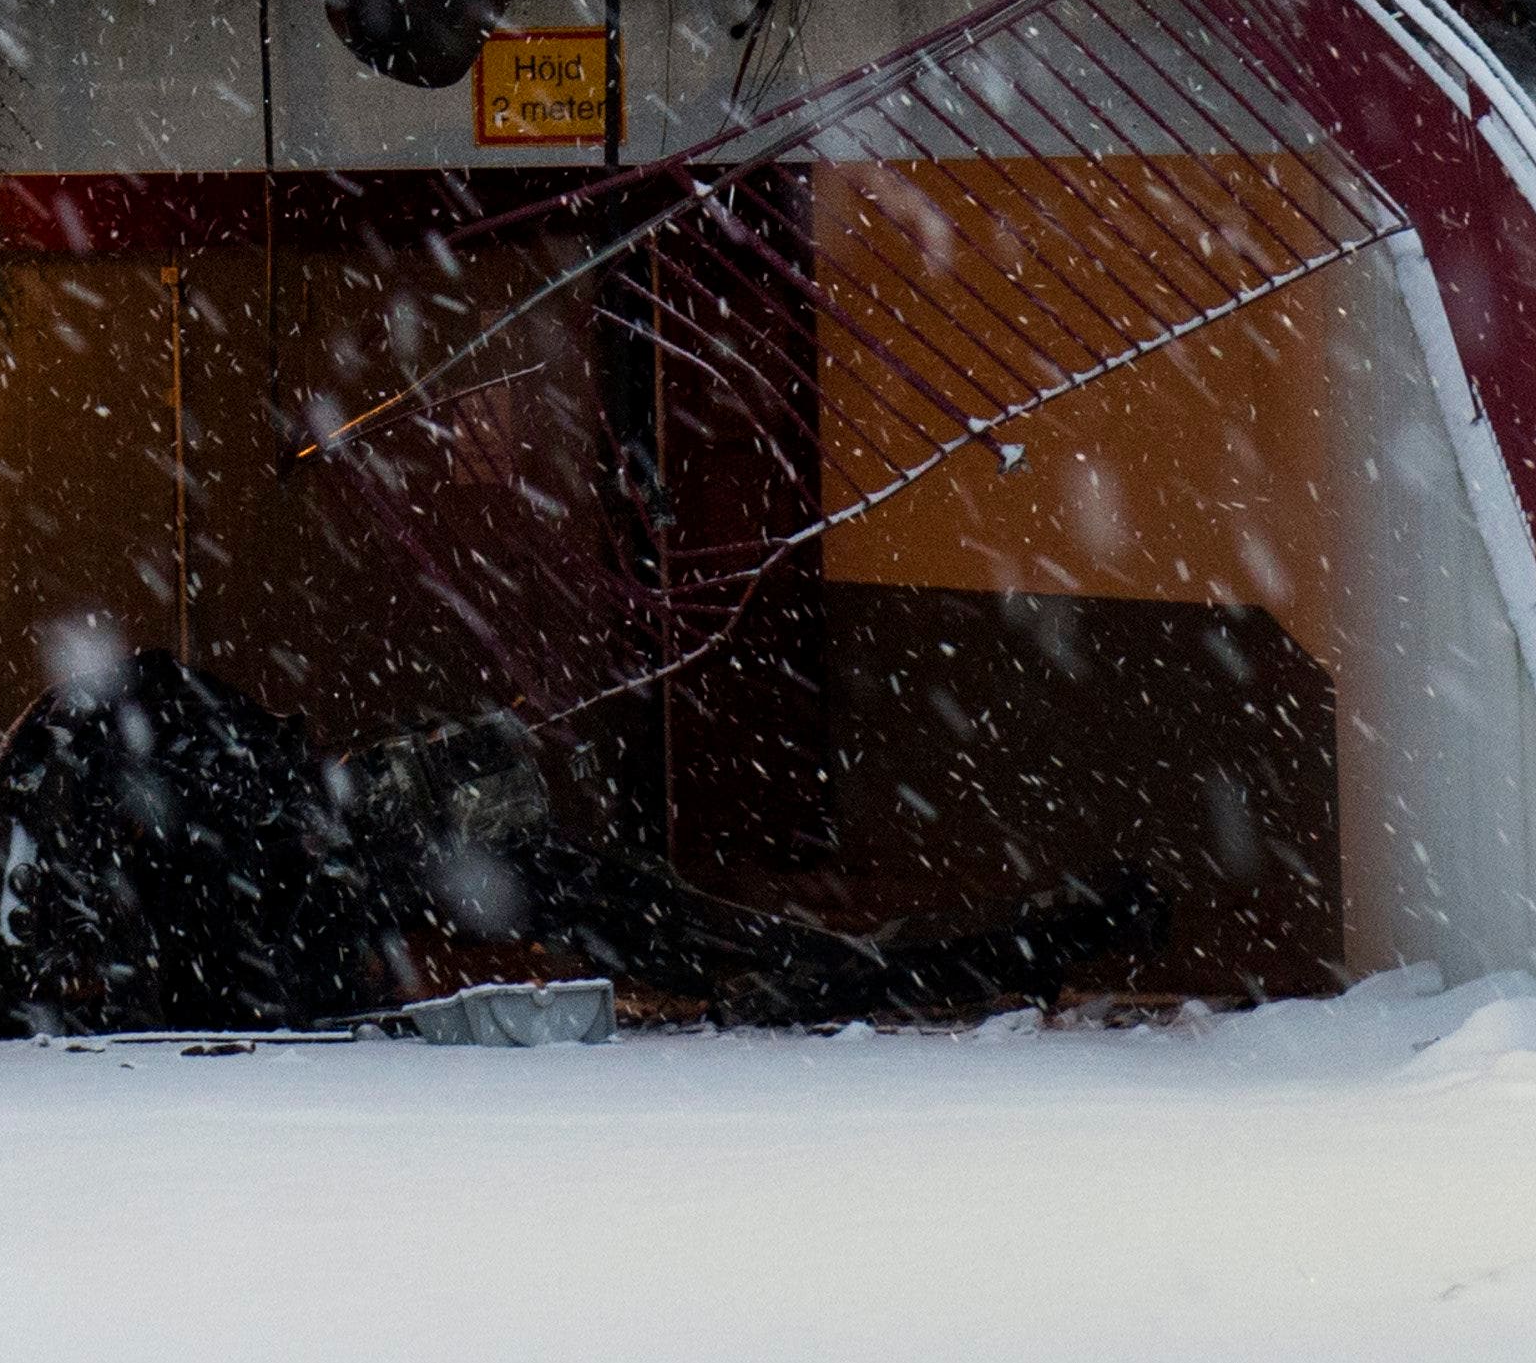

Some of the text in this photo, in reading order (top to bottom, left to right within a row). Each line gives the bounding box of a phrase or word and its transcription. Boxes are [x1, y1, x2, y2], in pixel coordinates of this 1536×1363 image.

[514, 54, 583, 87] Höjd
[492, 97, 609, 123] 2 meter
